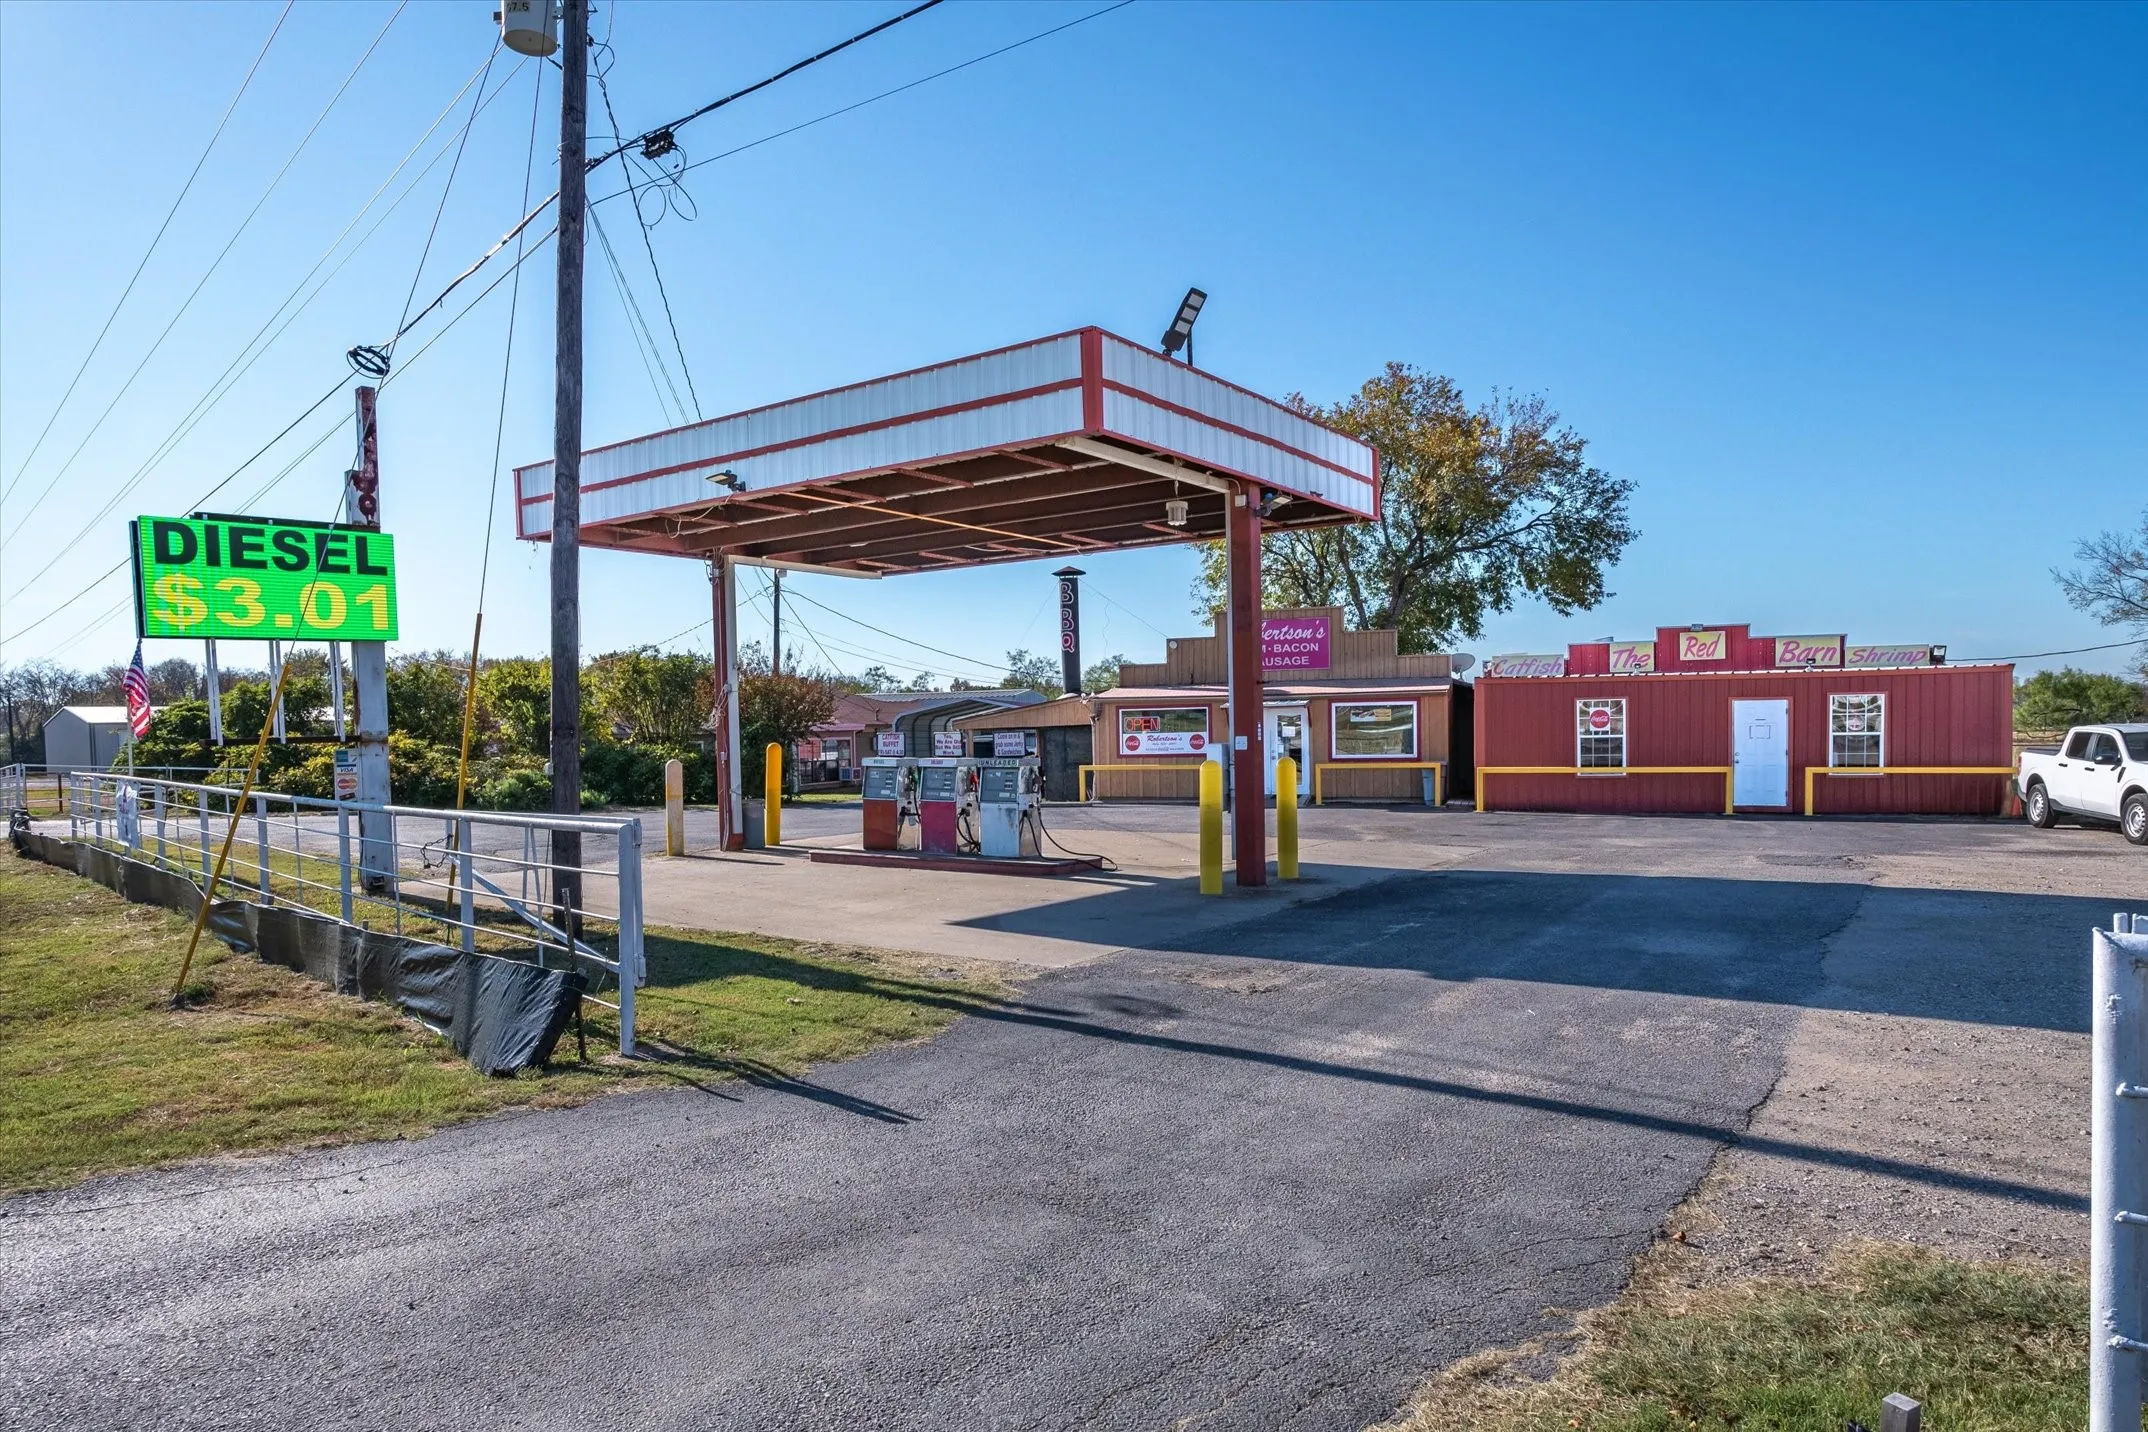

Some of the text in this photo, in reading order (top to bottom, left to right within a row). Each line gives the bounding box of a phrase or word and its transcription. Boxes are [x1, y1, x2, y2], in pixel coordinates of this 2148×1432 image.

[153, 520, 388, 577] DIESEL
[152, 572, 389, 633] $3.01
[1060, 581, 1075, 653] BBQ
[1683, 632, 1721, 659] Red
[1779, 639, 1838, 663] Barn
[1848, 646, 1928, 664] Shrimp
[1262, 655, 1310, 666] USAGE
[1493, 653, 1563, 676] Catfish
[1612, 646, 1651, 670] The
[1125, 718, 1159, 731] OPEN
[1147, 734, 1183, 742] Robertson's
